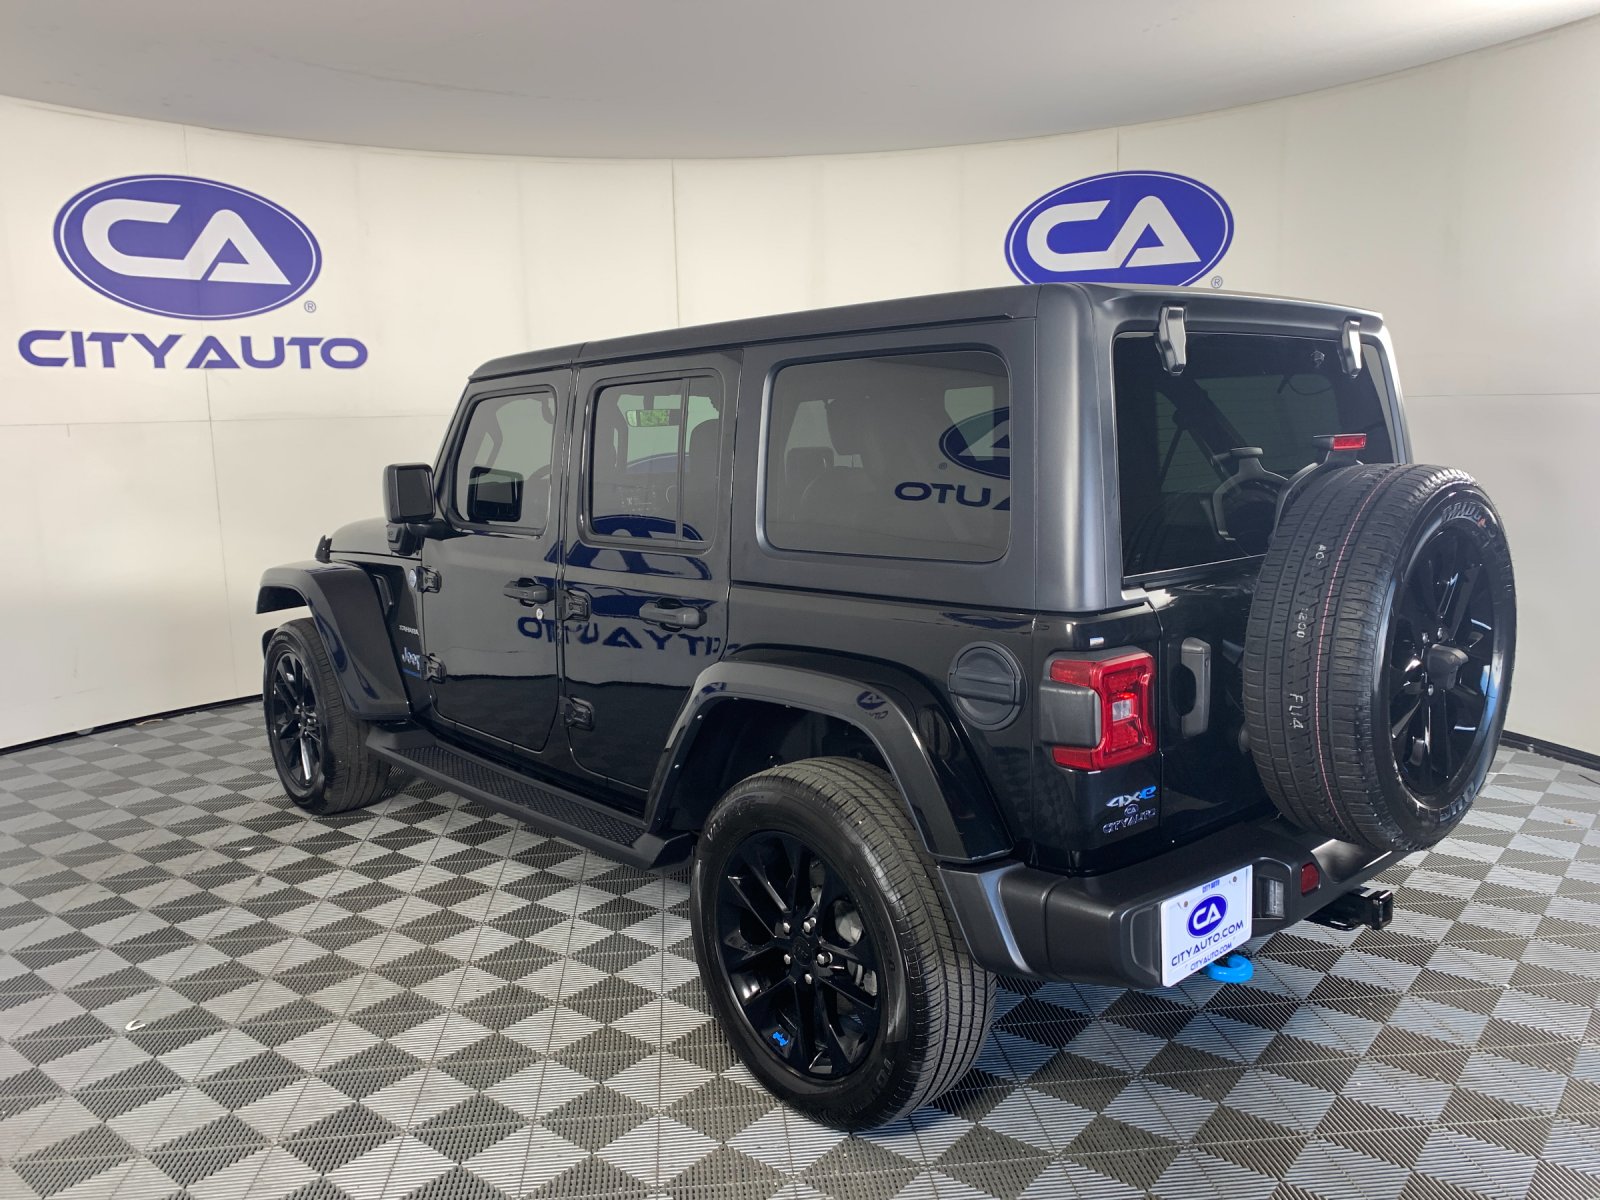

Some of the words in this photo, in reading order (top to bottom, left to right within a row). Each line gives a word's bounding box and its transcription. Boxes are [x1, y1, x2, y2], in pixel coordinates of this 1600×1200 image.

[82, 198, 292, 286] CA
[1026, 195, 1202, 272] CA
[1171, 920, 1244, 967] CITYAUTO.COM
[1193, 902, 1222, 930] CA
